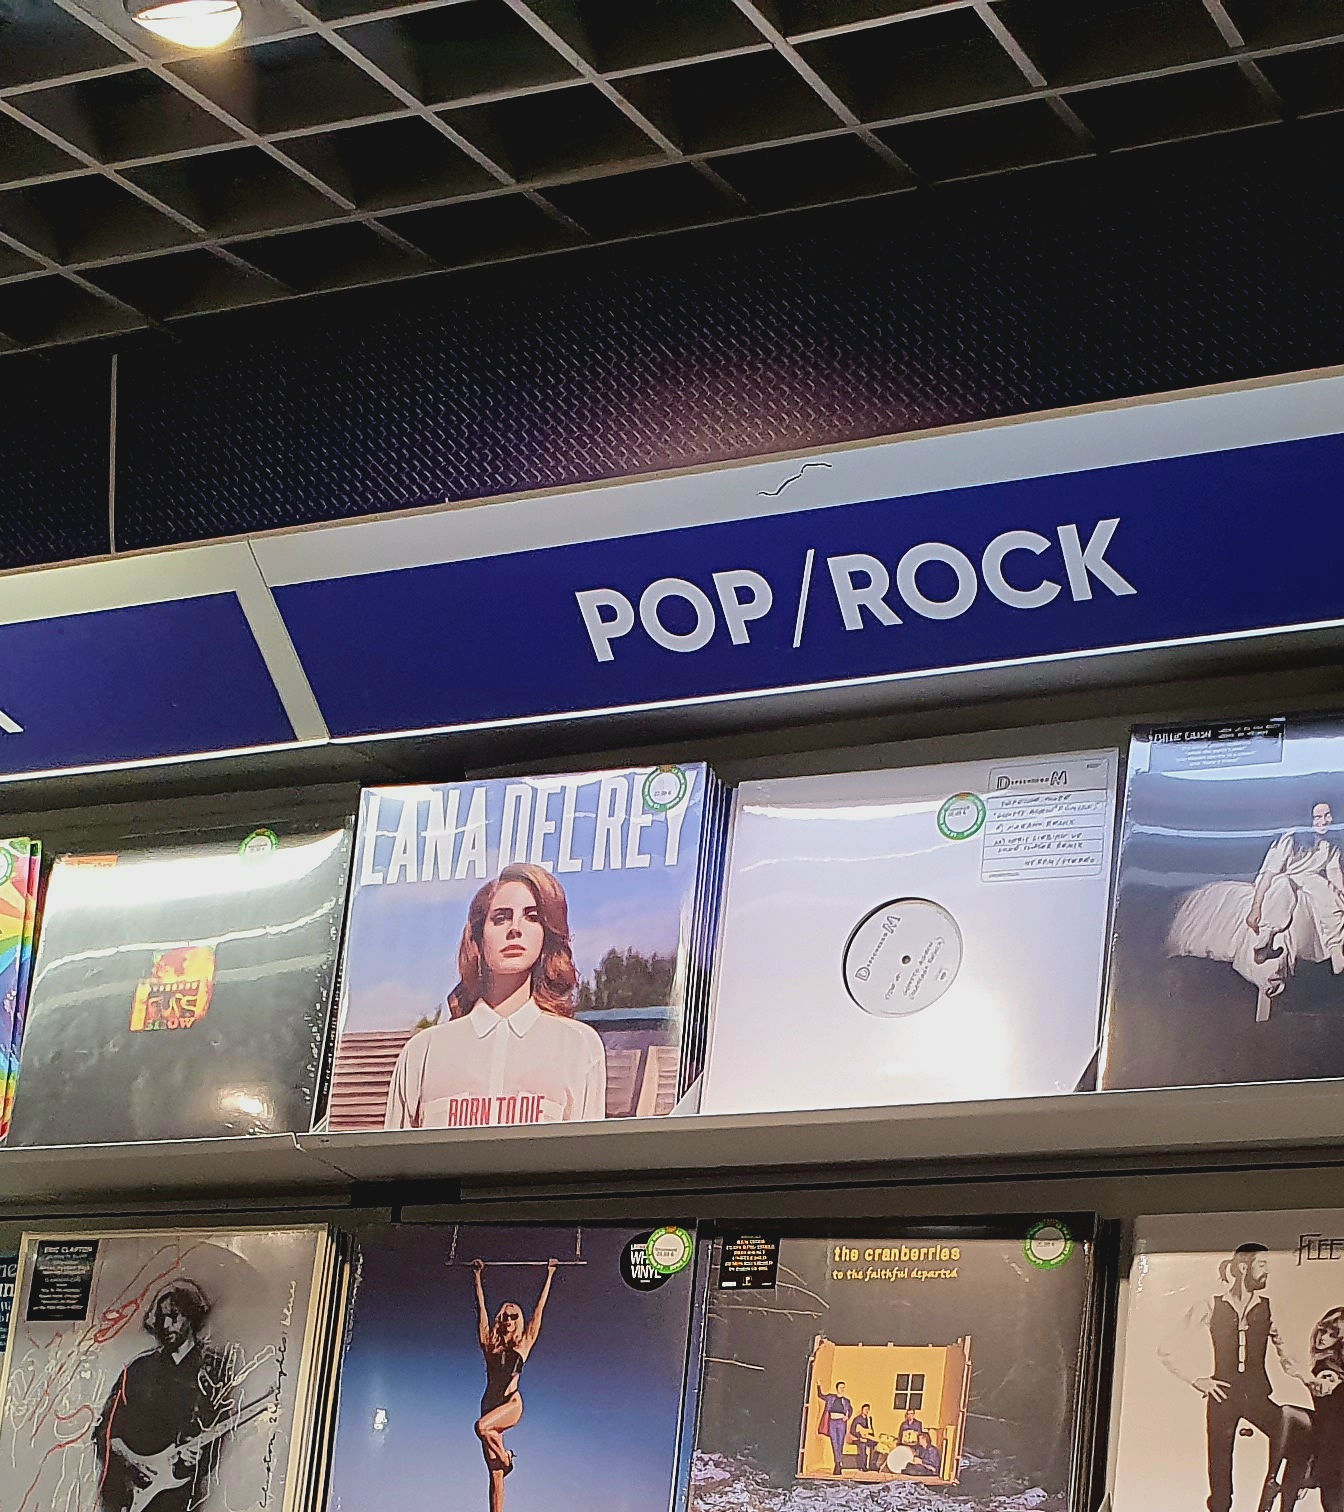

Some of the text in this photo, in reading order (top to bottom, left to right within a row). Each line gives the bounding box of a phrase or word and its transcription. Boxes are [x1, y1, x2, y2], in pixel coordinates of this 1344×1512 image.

[574, 518, 1137, 662] POP/ROCK
[360, 770, 698, 886] LANA DEL REY
[448, 1094, 545, 1127] BORN TO DIE
[834, 1244, 961, 1262] the cranberries
[631, 1265, 662, 1279] VINYL
[832, 1266, 958, 1282] to the faithful departed
